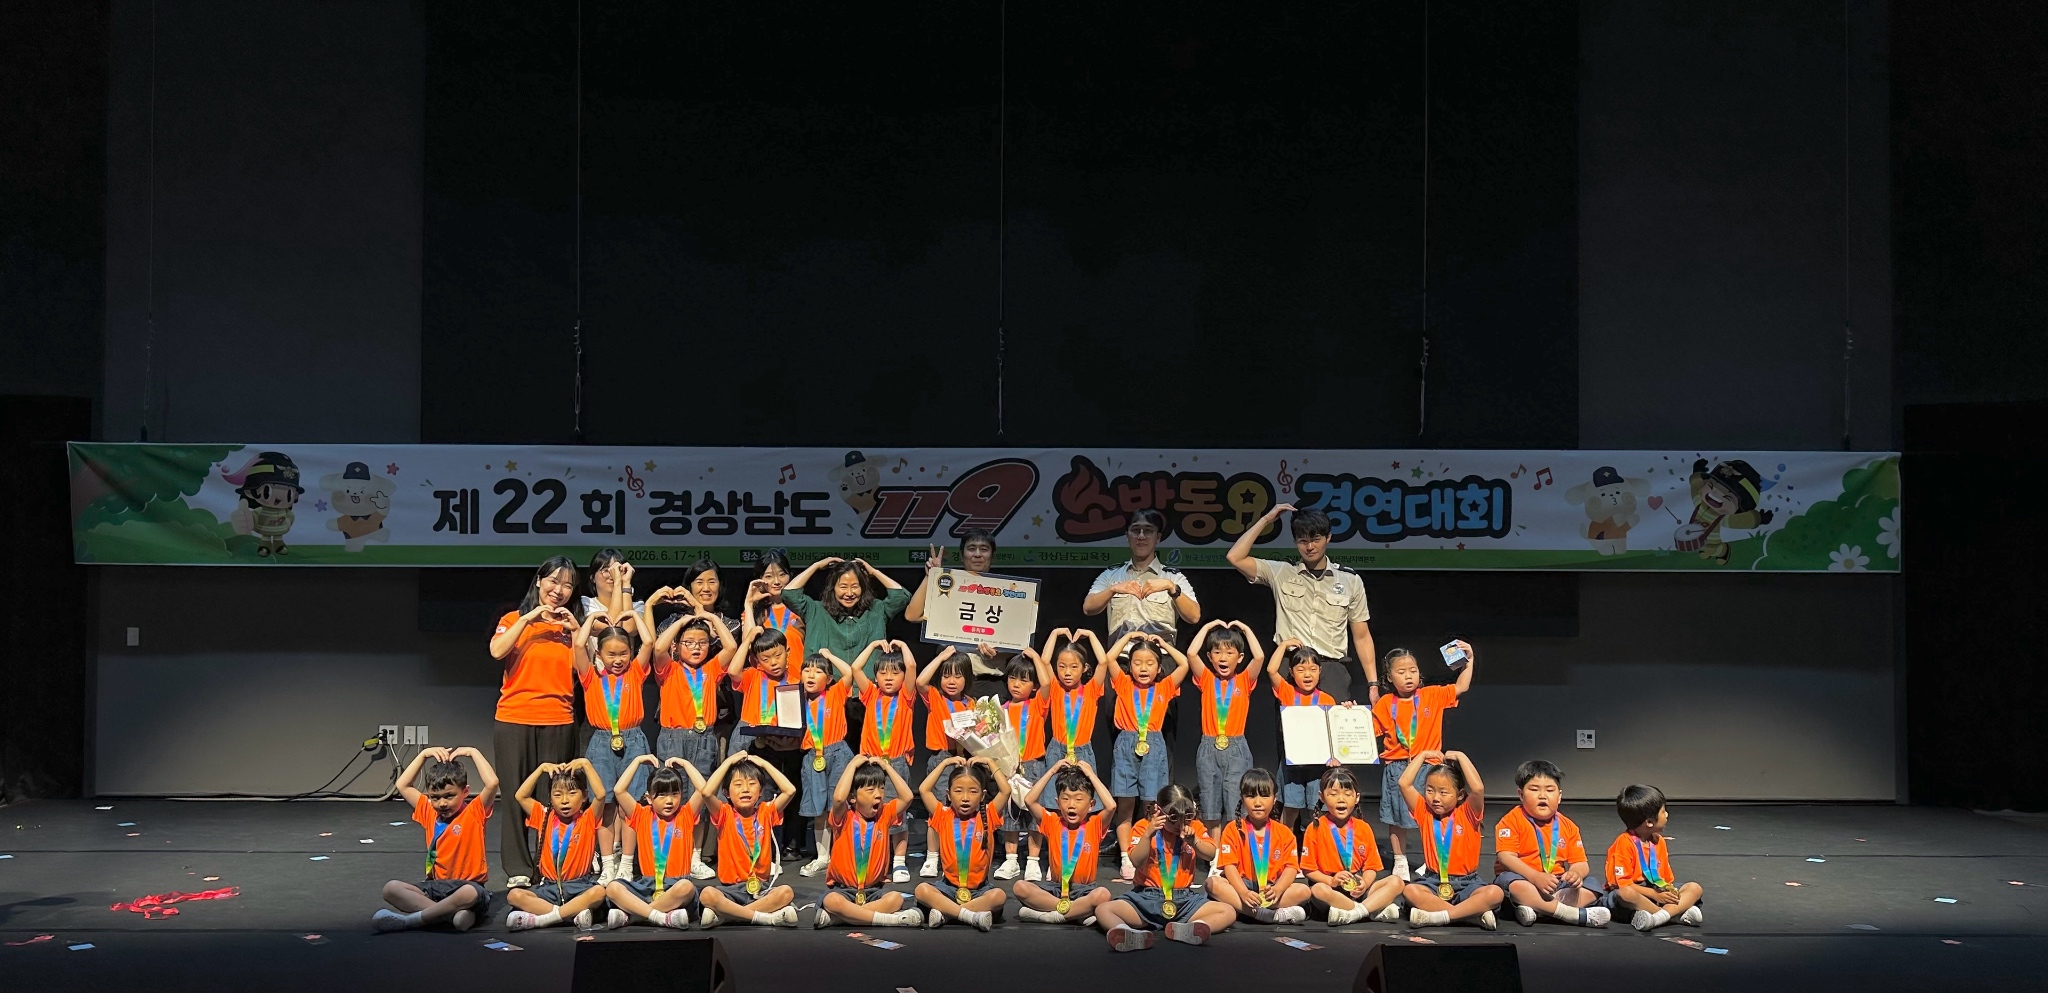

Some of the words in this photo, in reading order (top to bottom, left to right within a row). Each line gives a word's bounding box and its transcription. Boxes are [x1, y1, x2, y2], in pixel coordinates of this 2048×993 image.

[433, 489, 480, 535] 제
[493, 478, 568, 534] 22
[580, 488, 627, 535] 회
[648, 489, 836, 535] 경상남도
[862, 459, 1039, 537] 119
[1298, 476, 1508, 539] 경연대회
[742, 551, 759, 561] 장소
[910, 551, 927, 561] 주최
[1037, 551, 1110, 561] 경상남도교육청
